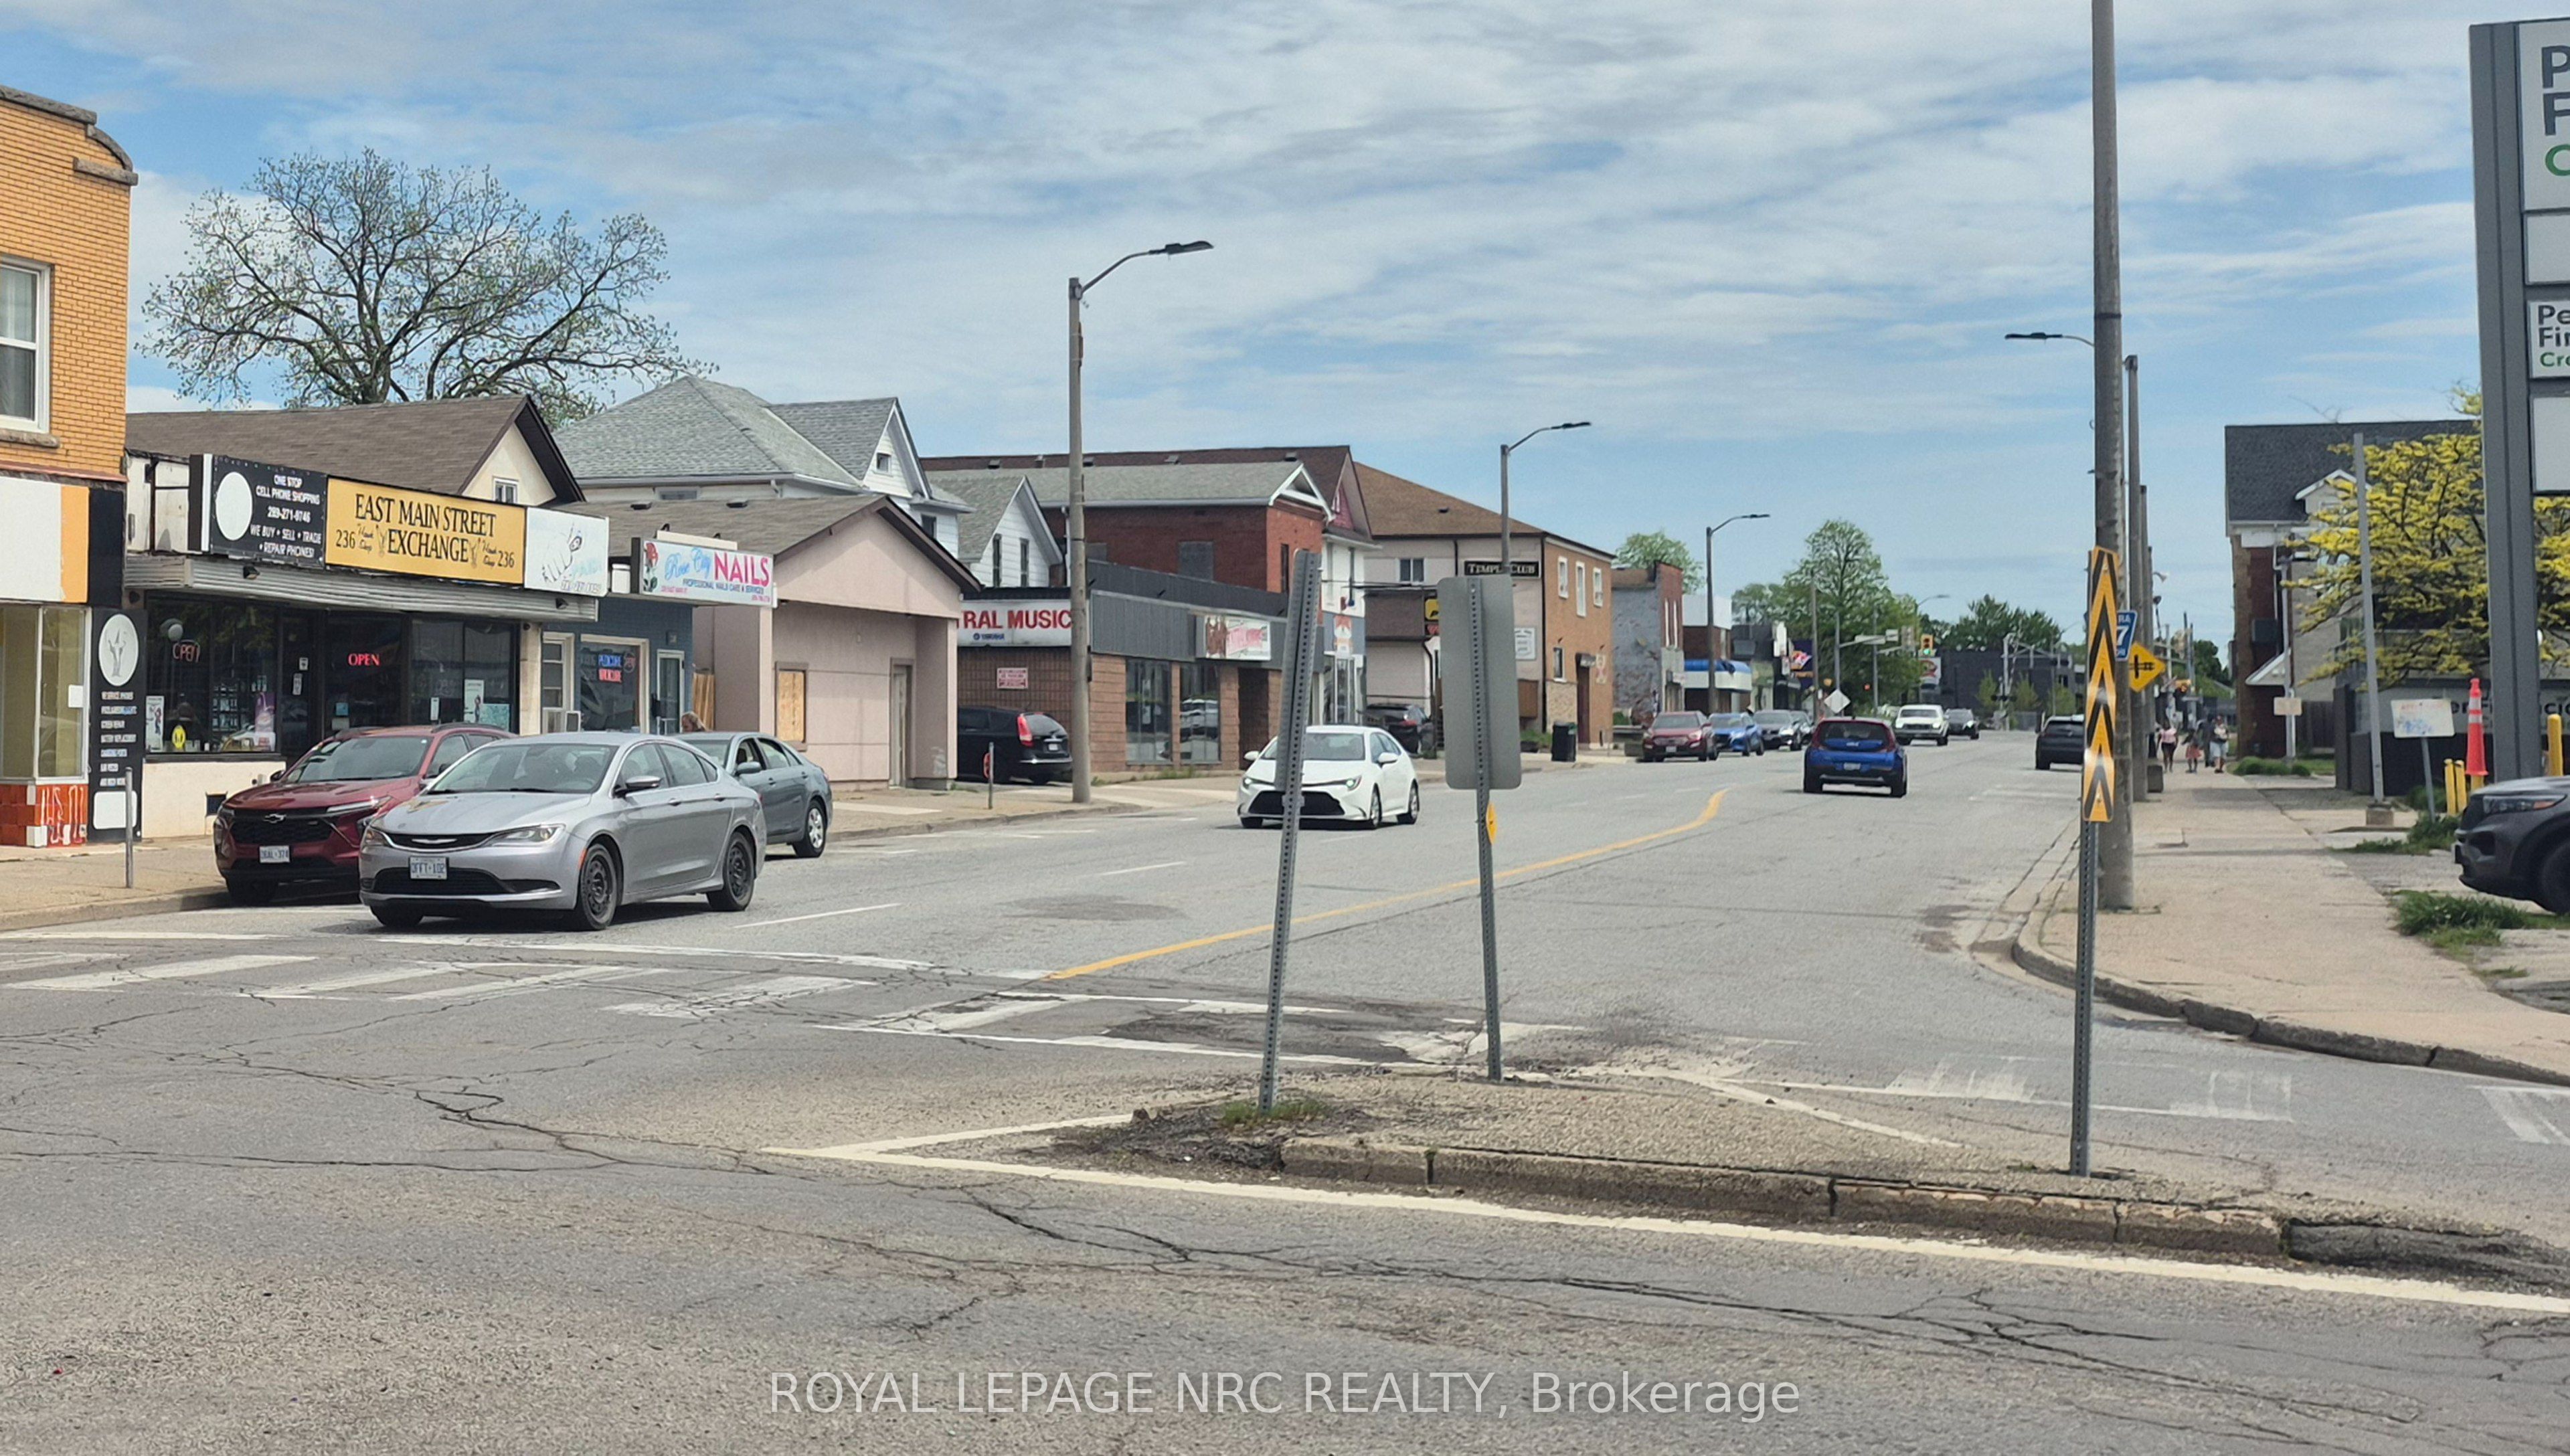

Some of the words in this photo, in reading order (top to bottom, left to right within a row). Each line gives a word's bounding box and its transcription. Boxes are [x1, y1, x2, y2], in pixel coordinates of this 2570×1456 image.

[256, 485, 271, 498] CELL
[272, 488, 291, 500] PHONE
[292, 490, 320, 505] SHOPPING
[355, 493, 395, 523] EAST
[398, 500, 440, 529] MAIN
[443, 506, 496, 537] STREET
[262, 525, 276, 537] BUY
[282, 529, 295, 541] SELL
[303, 531, 321, 544] TRADE
[336, 529, 355, 549] 236
[388, 528, 468, 563] EXCHANGE
[498, 550, 514, 568] 236
[714, 552, 769, 587] NAILS
[1007, 610, 1072, 629] MUSIC
[2117, 626, 2129, 646] 7
[348, 653, 380, 666] OPEN
